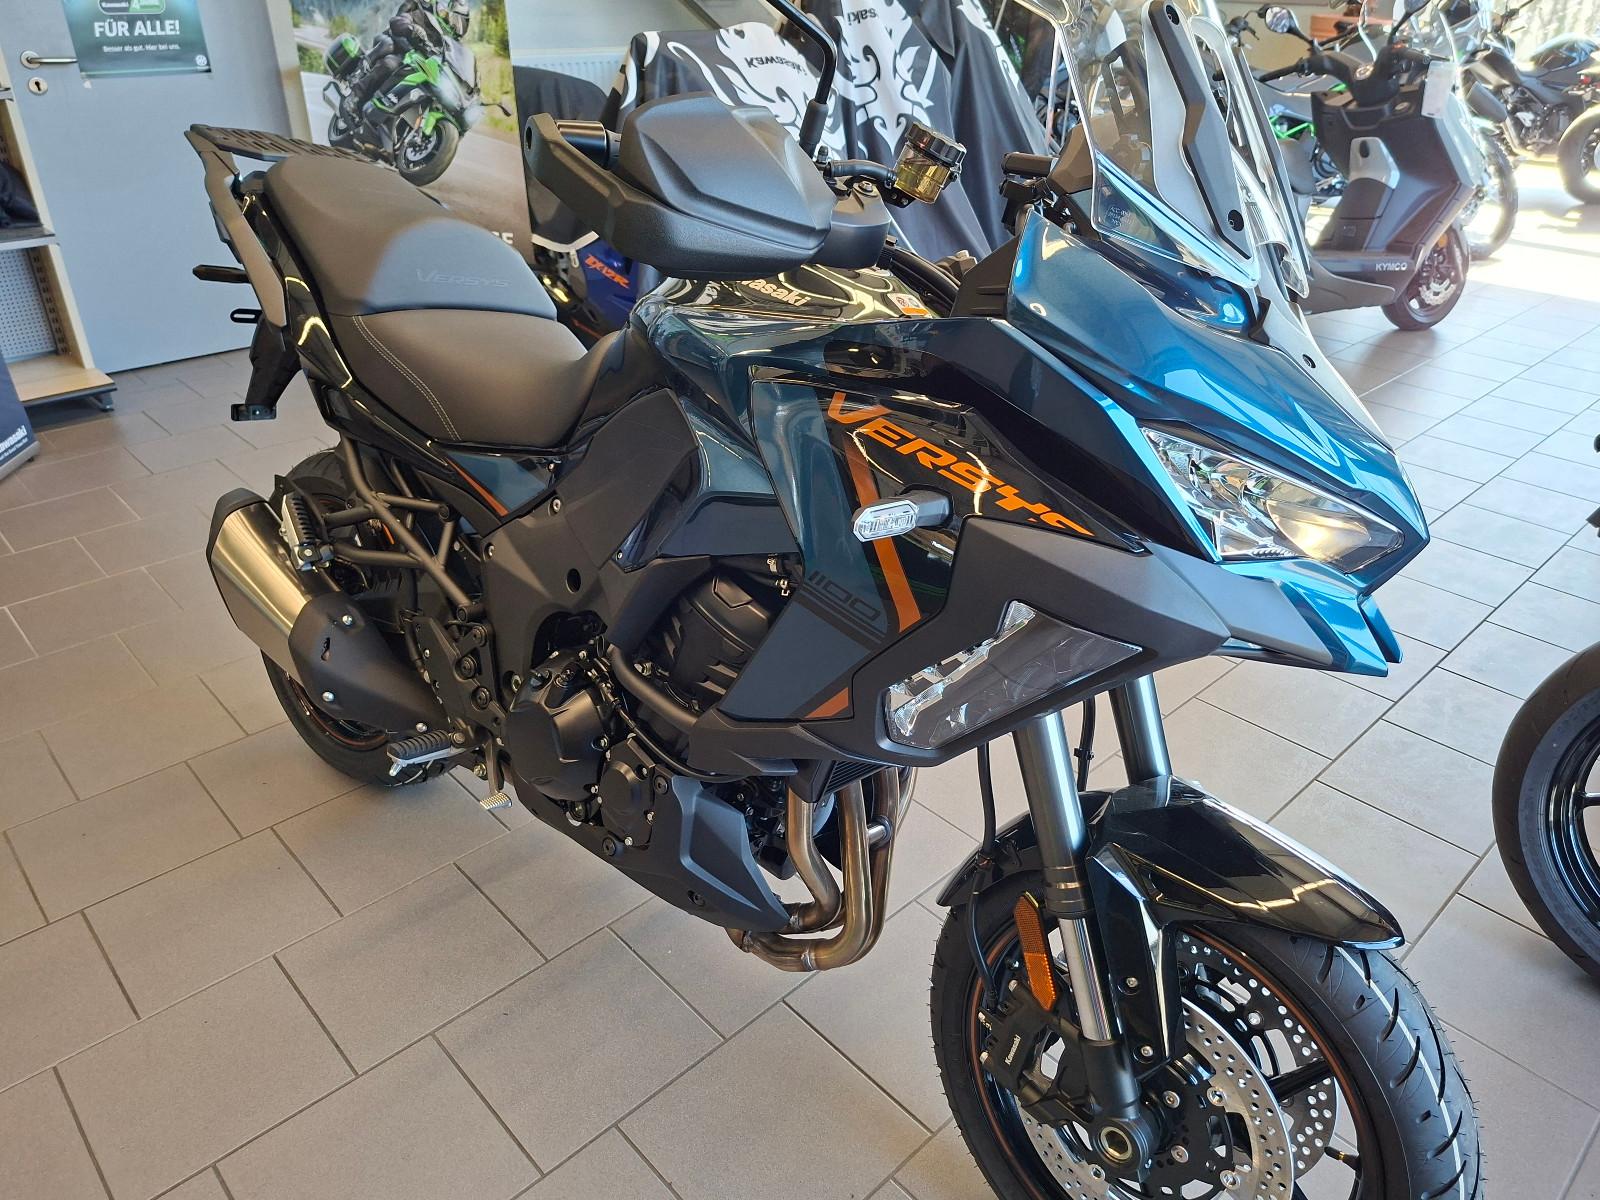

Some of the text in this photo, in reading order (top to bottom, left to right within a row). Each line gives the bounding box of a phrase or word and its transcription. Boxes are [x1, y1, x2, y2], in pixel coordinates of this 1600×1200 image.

[94, 19, 180, 37] FÜR ALLE!
[848, 8, 877, 26] saki
[1375, 262, 1408, 271] KYMCO
[738, 279, 811, 307] asaki
[0, 425, 27, 453] awasaki
[808, 570, 881, 621] 1100
